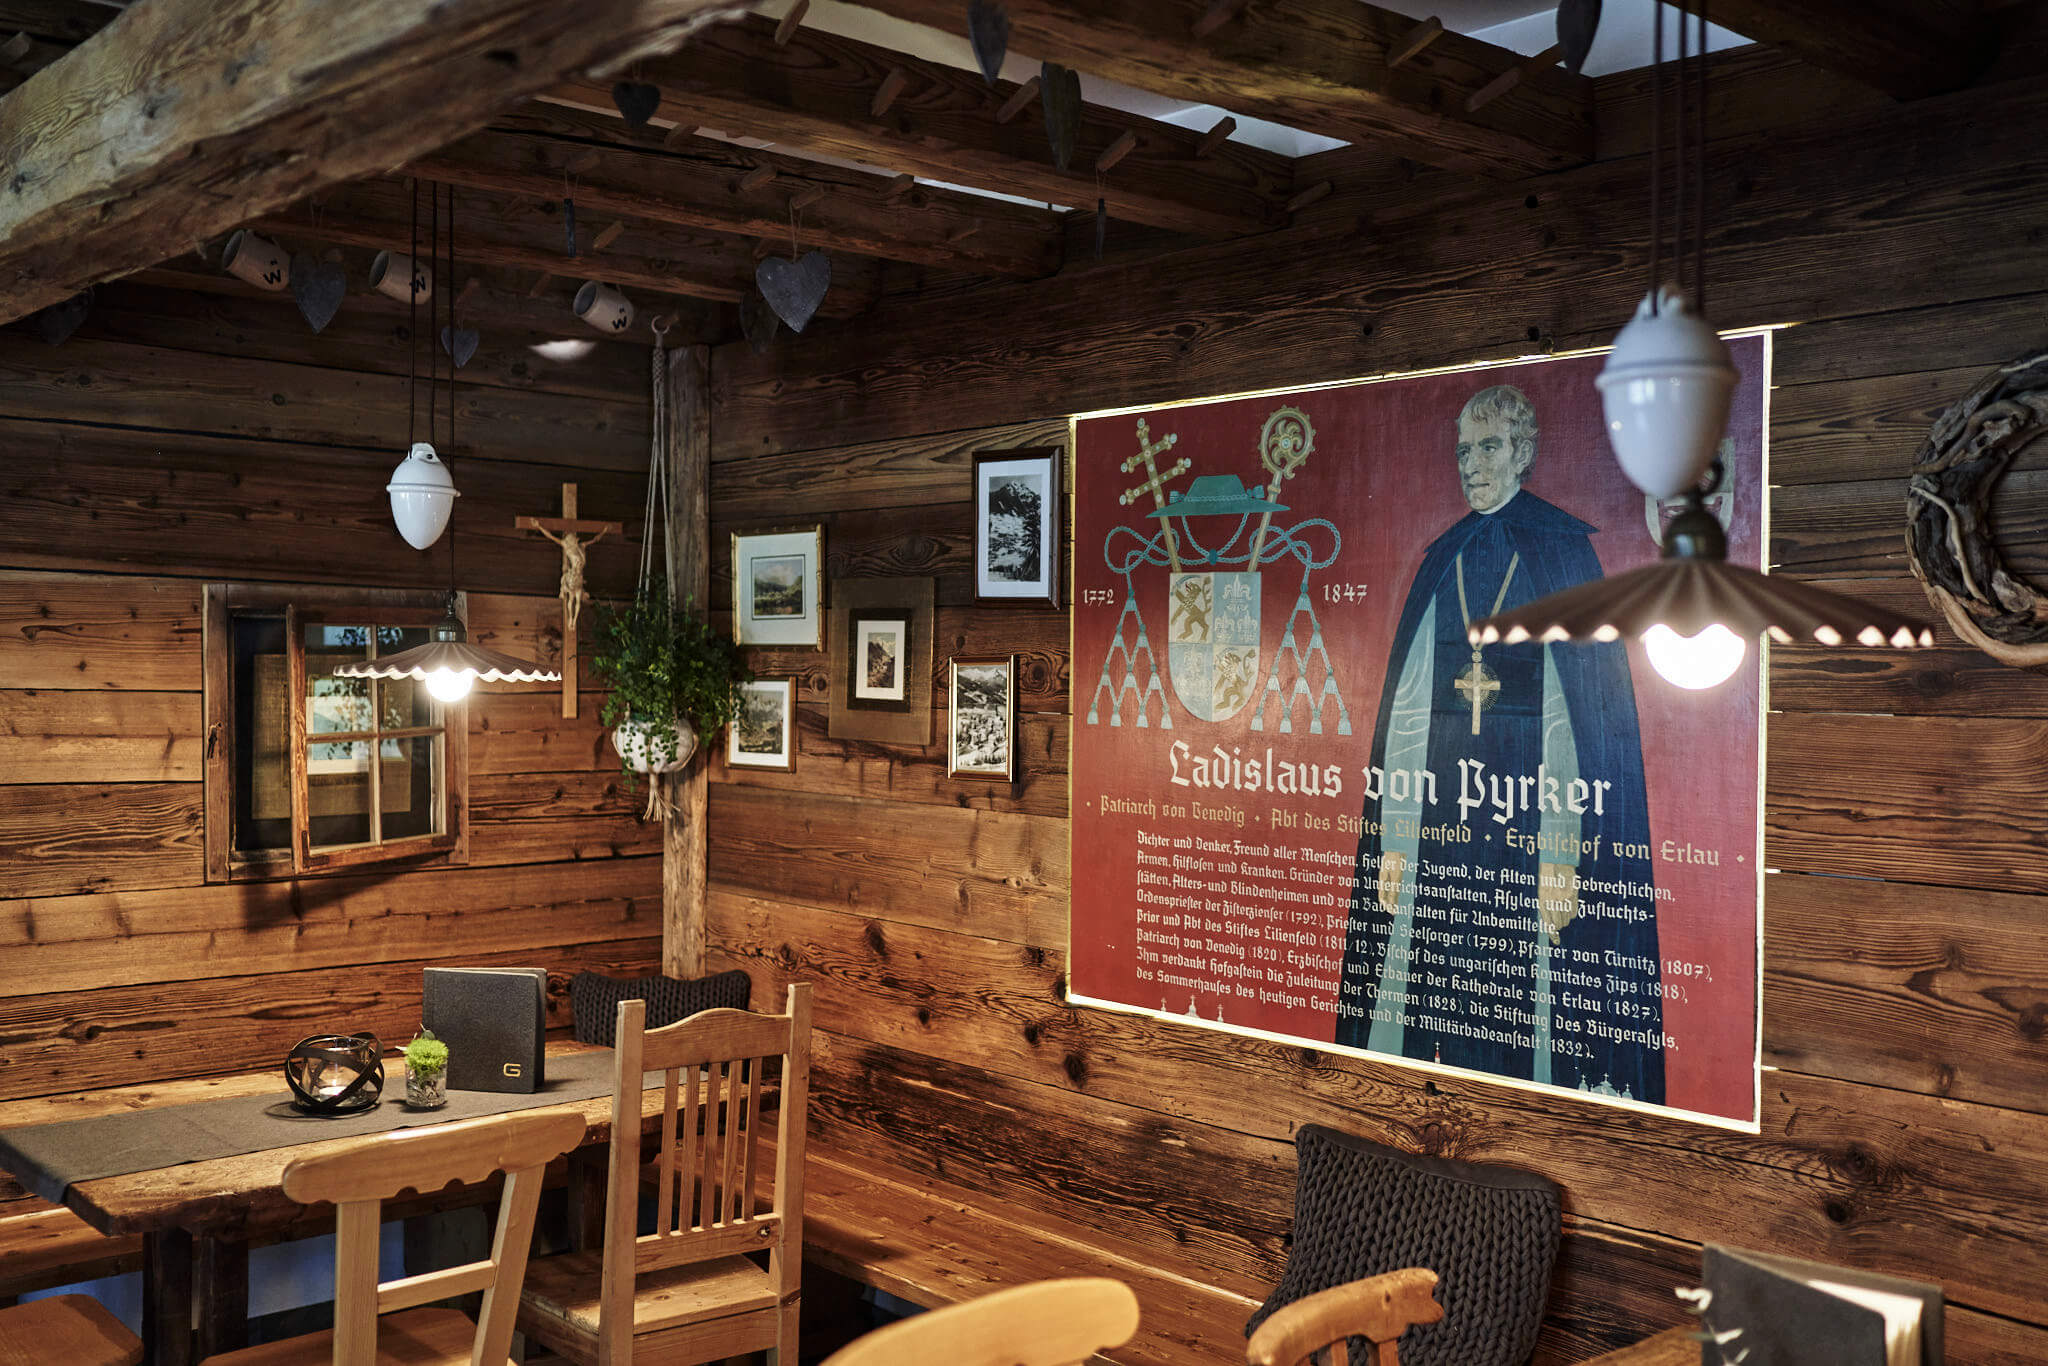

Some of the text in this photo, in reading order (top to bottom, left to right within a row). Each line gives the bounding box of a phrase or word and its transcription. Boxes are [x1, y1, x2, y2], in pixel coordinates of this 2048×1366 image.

[1083, 588, 1115, 606] 1772
[1322, 583, 1368, 605] 1847
[1169, 739, 1612, 826] Ladislaus von Pyrker
[1100, 794, 1156, 820] Patriarch
[1162, 804, 1185, 818] von
[1191, 802, 1245, 828] Venedig
[1271, 808, 1298, 831] Abt
[1303, 811, 1330, 831] des
[1337, 813, 1386, 839] Stiftes
[1394, 818, 1472, 846] Lilienfeld
[1612, 841, 1651, 860] von
[1660, 840, 1720, 866] Erlau
[1136, 831, 1170, 849] Dichter
[1173, 836, 1192, 849] und
[1195, 837, 1231, 855] Denker,
[1232, 840, 1269, 858] Freund
[1273, 845, 1297, 860] aller
[1362, 853, 1396, 873] Helfer
[1399, 857, 1419, 873] der
[1421, 859, 1471, 881] Jugend,
[1475, 865, 1495, 882] der
[1499, 867, 1536, 887] Alten
[1540, 873, 1565, 889] und
[1571, 874, 1675, 903] Gebrechlichen,
[1217, 860, 1237, 874] und
[1289, 866, 1334, 885] Gründer
[1337, 876, 1359, 888] von
[1545, 896, 1572, 912] und
[1576, 897, 1655, 923] Zufluchts-
[1230, 880, 1308, 903] Blindenheimen
[1311, 892, 1334, 907] und
[1337, 897, 1358, 910] von
[1449, 906, 1468, 925] für
[1136, 908, 1160, 924] Prior
[1162, 913, 1180, 927] und
[1183, 914, 1202, 931] Abt
[1204, 917, 1222, 933] des
[1224, 920, 1260, 939] Stiftes
[1264, 925, 1316, 947] Lilienfeld
[1423, 948, 1445, 965] des
[1530, 963, 1601, 988] Komitates
[1604, 973, 1638, 996] Zips
[1640, 978, 1688, 1004] (1818),
[1136, 927, 1180, 950] Patriarch
[1182, 938, 1202, 950] von
[1205, 937, 1245, 960] Venedig
[1247, 944, 1284, 966] (1820),
[1347, 961, 1369, 976] und
[1375, 963, 1422, 984] Erbauer
[1426, 970, 1447, 988] der
[1451, 974, 1523, 1000] Kathedrale
[1529, 990, 1556, 1005] von
[1561, 991, 1601, 1012] Erlau
[1606, 997, 1660, 1024] (1827).
[1205, 898, 1221, 913] der
[1285, 908, 1324, 930] (1792),
[1372, 921, 1394, 936] und
[1466, 931, 1516, 956] (1799),
[1517, 938, 1567, 960] Pfarrer
[1572, 950, 1599, 964] von
[1603, 949, 1655, 975] Türnitz
[1660, 957, 1712, 983] (1807),
[1136, 946, 1158, 964] Ihm
[1161, 953, 1206, 970] verdankt
[1266, 967, 1283, 983] die
[1285, 970, 1340, 996] Zuleitung
[1343, 979, 1362, 996] der
[1365, 983, 1419, 1006] Thermen
[1422, 992, 1464, 1016] (1828),
[1469, 1000, 1489, 1018] die
[1493, 1003, 1549, 1031] Stiftung
[1555, 1013, 1581, 1033] des
[1136, 965, 1153, 981] des
[1235, 982, 1255, 999] des
[1258, 986, 1306, 1009] heutigen
[1310, 995, 1364, 1018] Gerichtes
[1368, 1008, 1392, 1023] und
[1395, 1010, 1416, 1028] der
[503, 1062, 521, 1077] G
